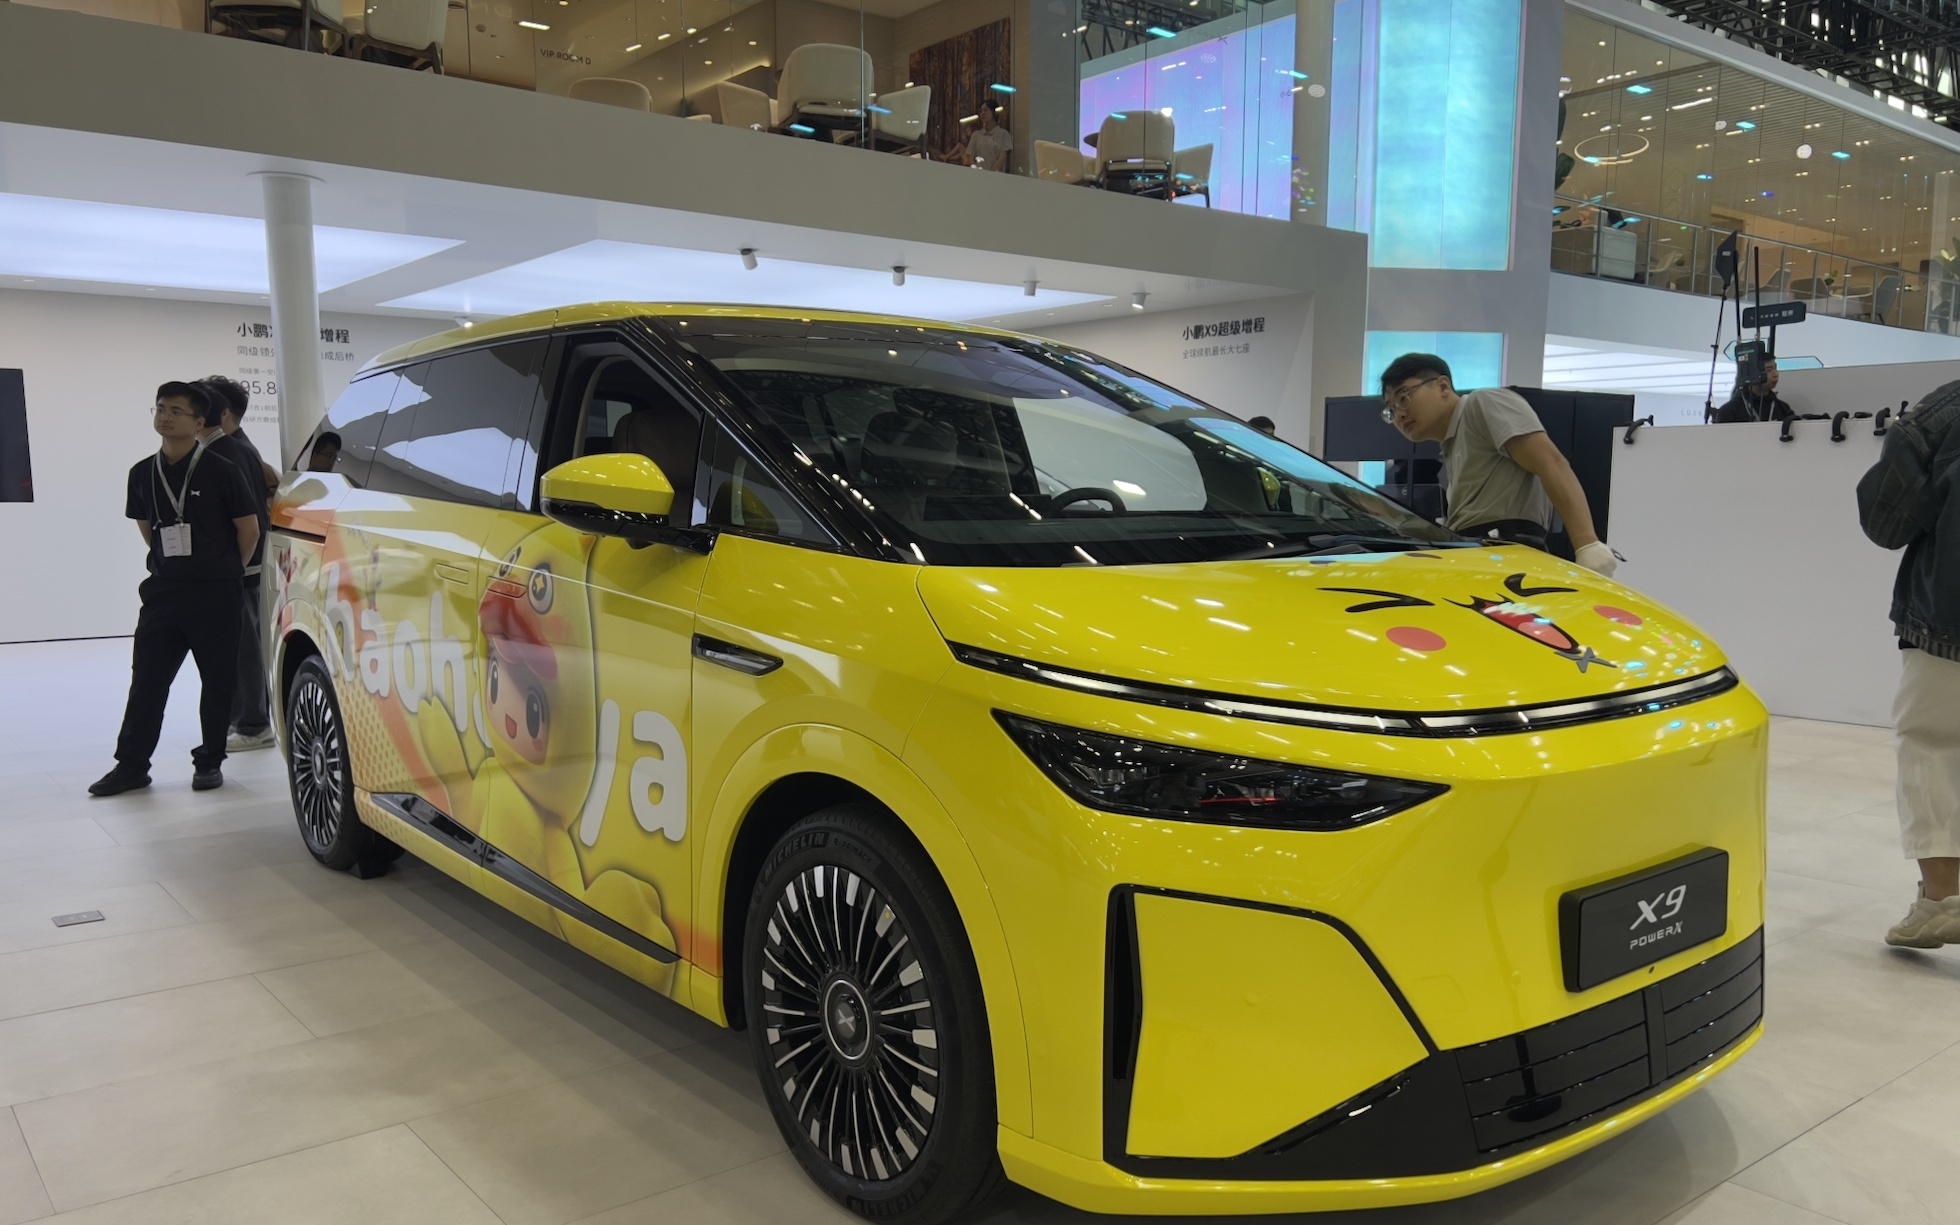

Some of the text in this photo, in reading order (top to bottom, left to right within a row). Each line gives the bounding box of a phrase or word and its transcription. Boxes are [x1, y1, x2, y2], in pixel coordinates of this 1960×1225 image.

[540, 49, 555, 58] VIP
[585, 57, 592, 65] D
[1182, 317, 1266, 341] 小鹏X9超级增程
[765, 832, 826, 881] MICHELIN
[1629, 884, 1687, 930] X9
